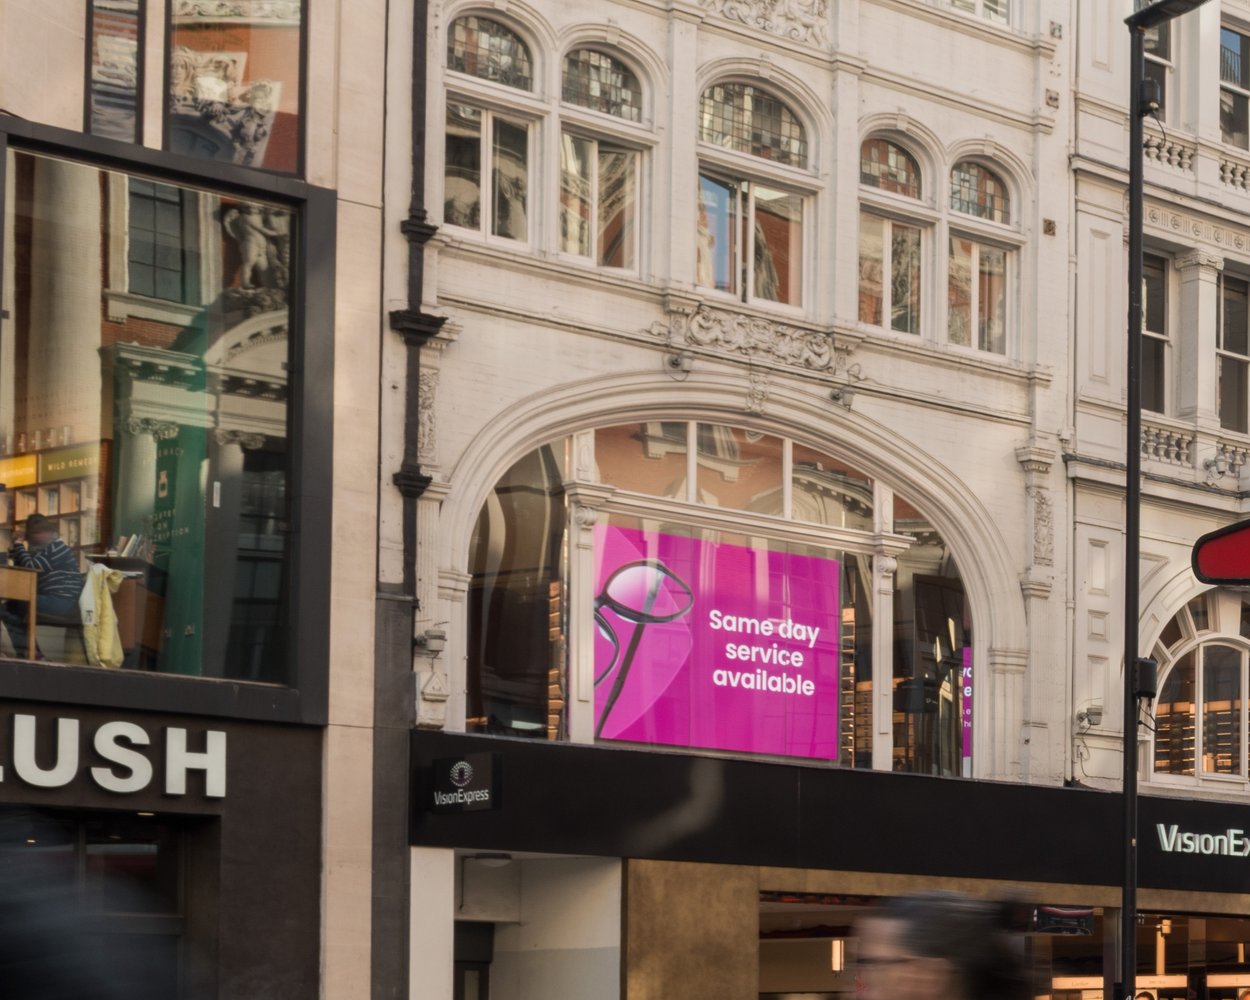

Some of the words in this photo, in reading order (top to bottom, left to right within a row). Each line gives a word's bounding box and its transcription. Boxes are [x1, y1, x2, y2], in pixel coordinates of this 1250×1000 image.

[709, 609, 774, 638] Same
[778, 619, 820, 648] day
[725, 642, 804, 667] service
[712, 668, 815, 696] available
[0, 713, 227, 798] USH
[433, 788, 489, 806] VisionExpress
